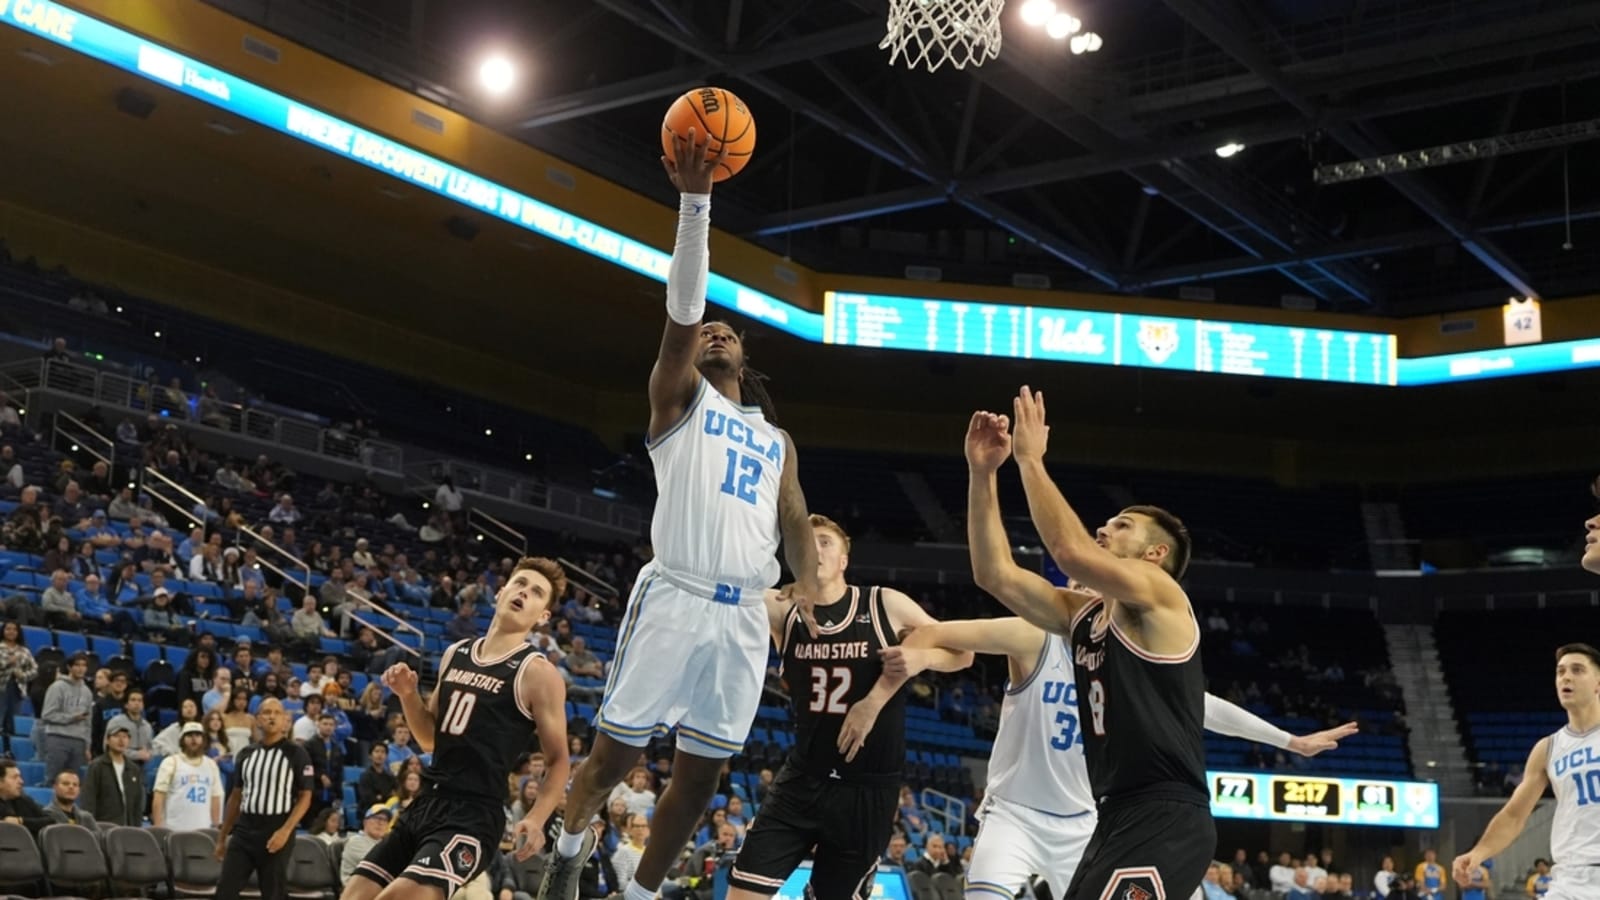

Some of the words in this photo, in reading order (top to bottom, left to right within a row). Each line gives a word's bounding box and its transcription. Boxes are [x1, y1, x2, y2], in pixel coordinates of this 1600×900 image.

[13, 0, 78, 42] CARE
[287, 104, 353, 152] WHERE
[351, 132, 448, 188] DISCOVERY
[447, 171, 499, 209] LEADS
[500, 191, 521, 217] TO
[1513, 316, 1533, 331] 42
[704, 409, 782, 473] UCLA
[720, 447, 763, 505] 12
[831, 641, 869, 659] STATE
[470, 673, 505, 694] STATE
[810, 666, 852, 714] 32
[1042, 681, 1077, 706] UC
[440, 689, 477, 736] 10
[1554, 747, 1600, 776] UCL
[186, 786, 207, 803] 42
[1220, 778, 1248, 798] 77
[1283, 781, 1329, 803] 2:17
